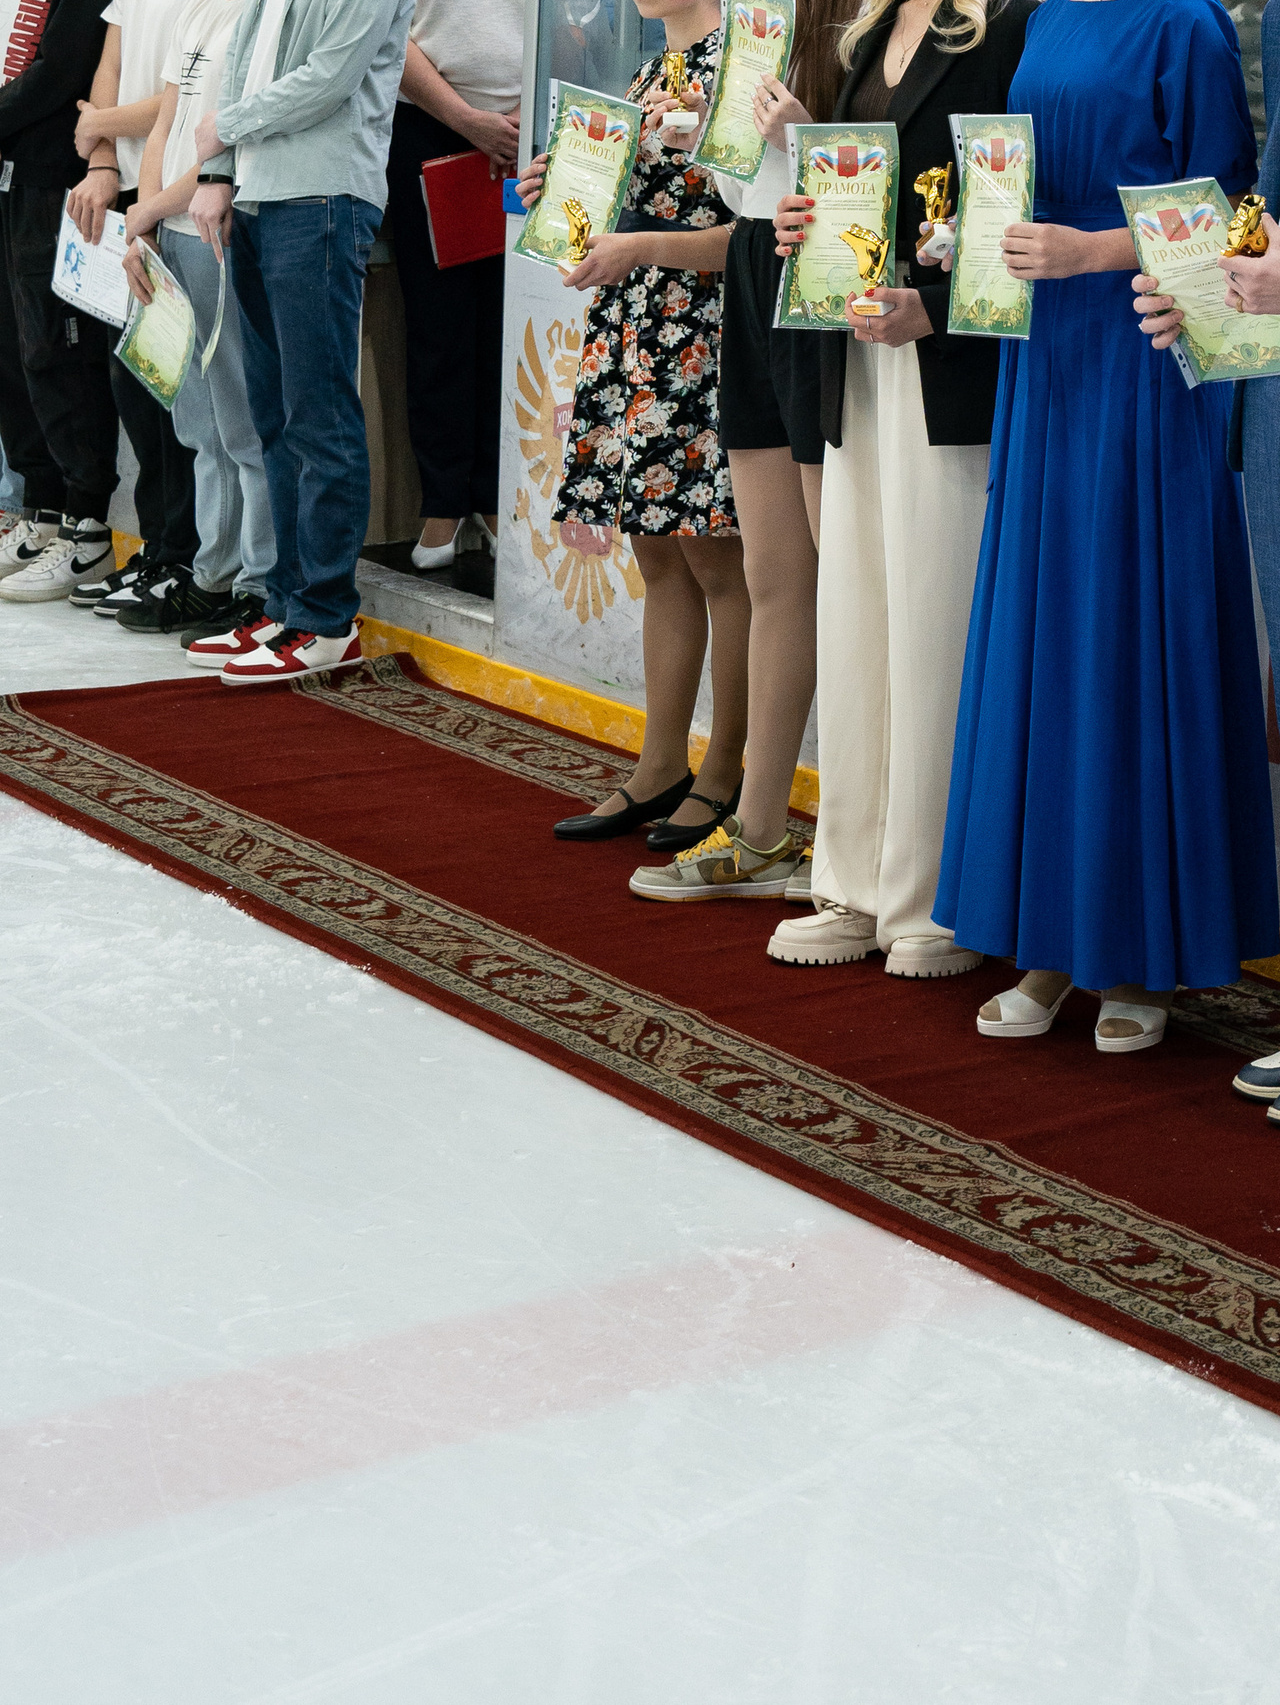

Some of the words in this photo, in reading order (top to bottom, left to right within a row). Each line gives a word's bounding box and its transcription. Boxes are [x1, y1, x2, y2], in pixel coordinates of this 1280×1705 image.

[738, 36, 776, 60] ГРАМОТА
[567, 136, 617, 163] ГРАМОТА
[816, 181, 877, 195] ГРАМОТА
[975, 177, 1019, 191] ГРАМОТА
[1151, 239, 1224, 264] ГРАМОТА
